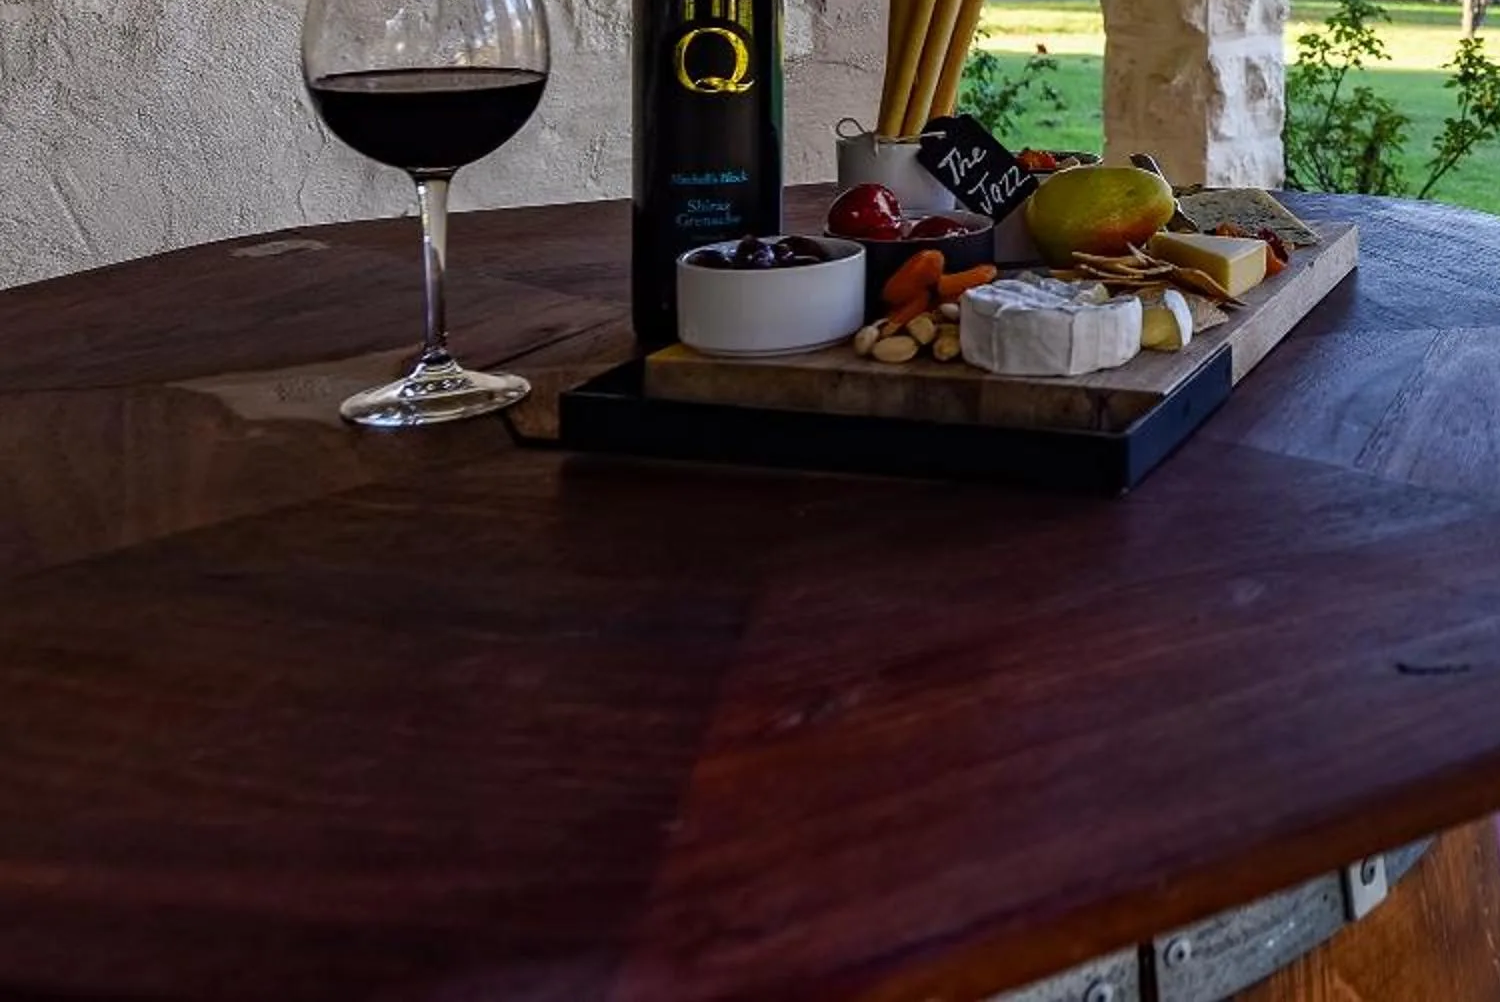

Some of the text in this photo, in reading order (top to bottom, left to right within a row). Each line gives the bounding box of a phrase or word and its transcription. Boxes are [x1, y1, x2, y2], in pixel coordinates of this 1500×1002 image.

[675, 27, 755, 94] Q
[937, 146, 987, 186] The
[686, 198, 731, 213] Shiraz
[966, 165, 1031, 215] Jazz
